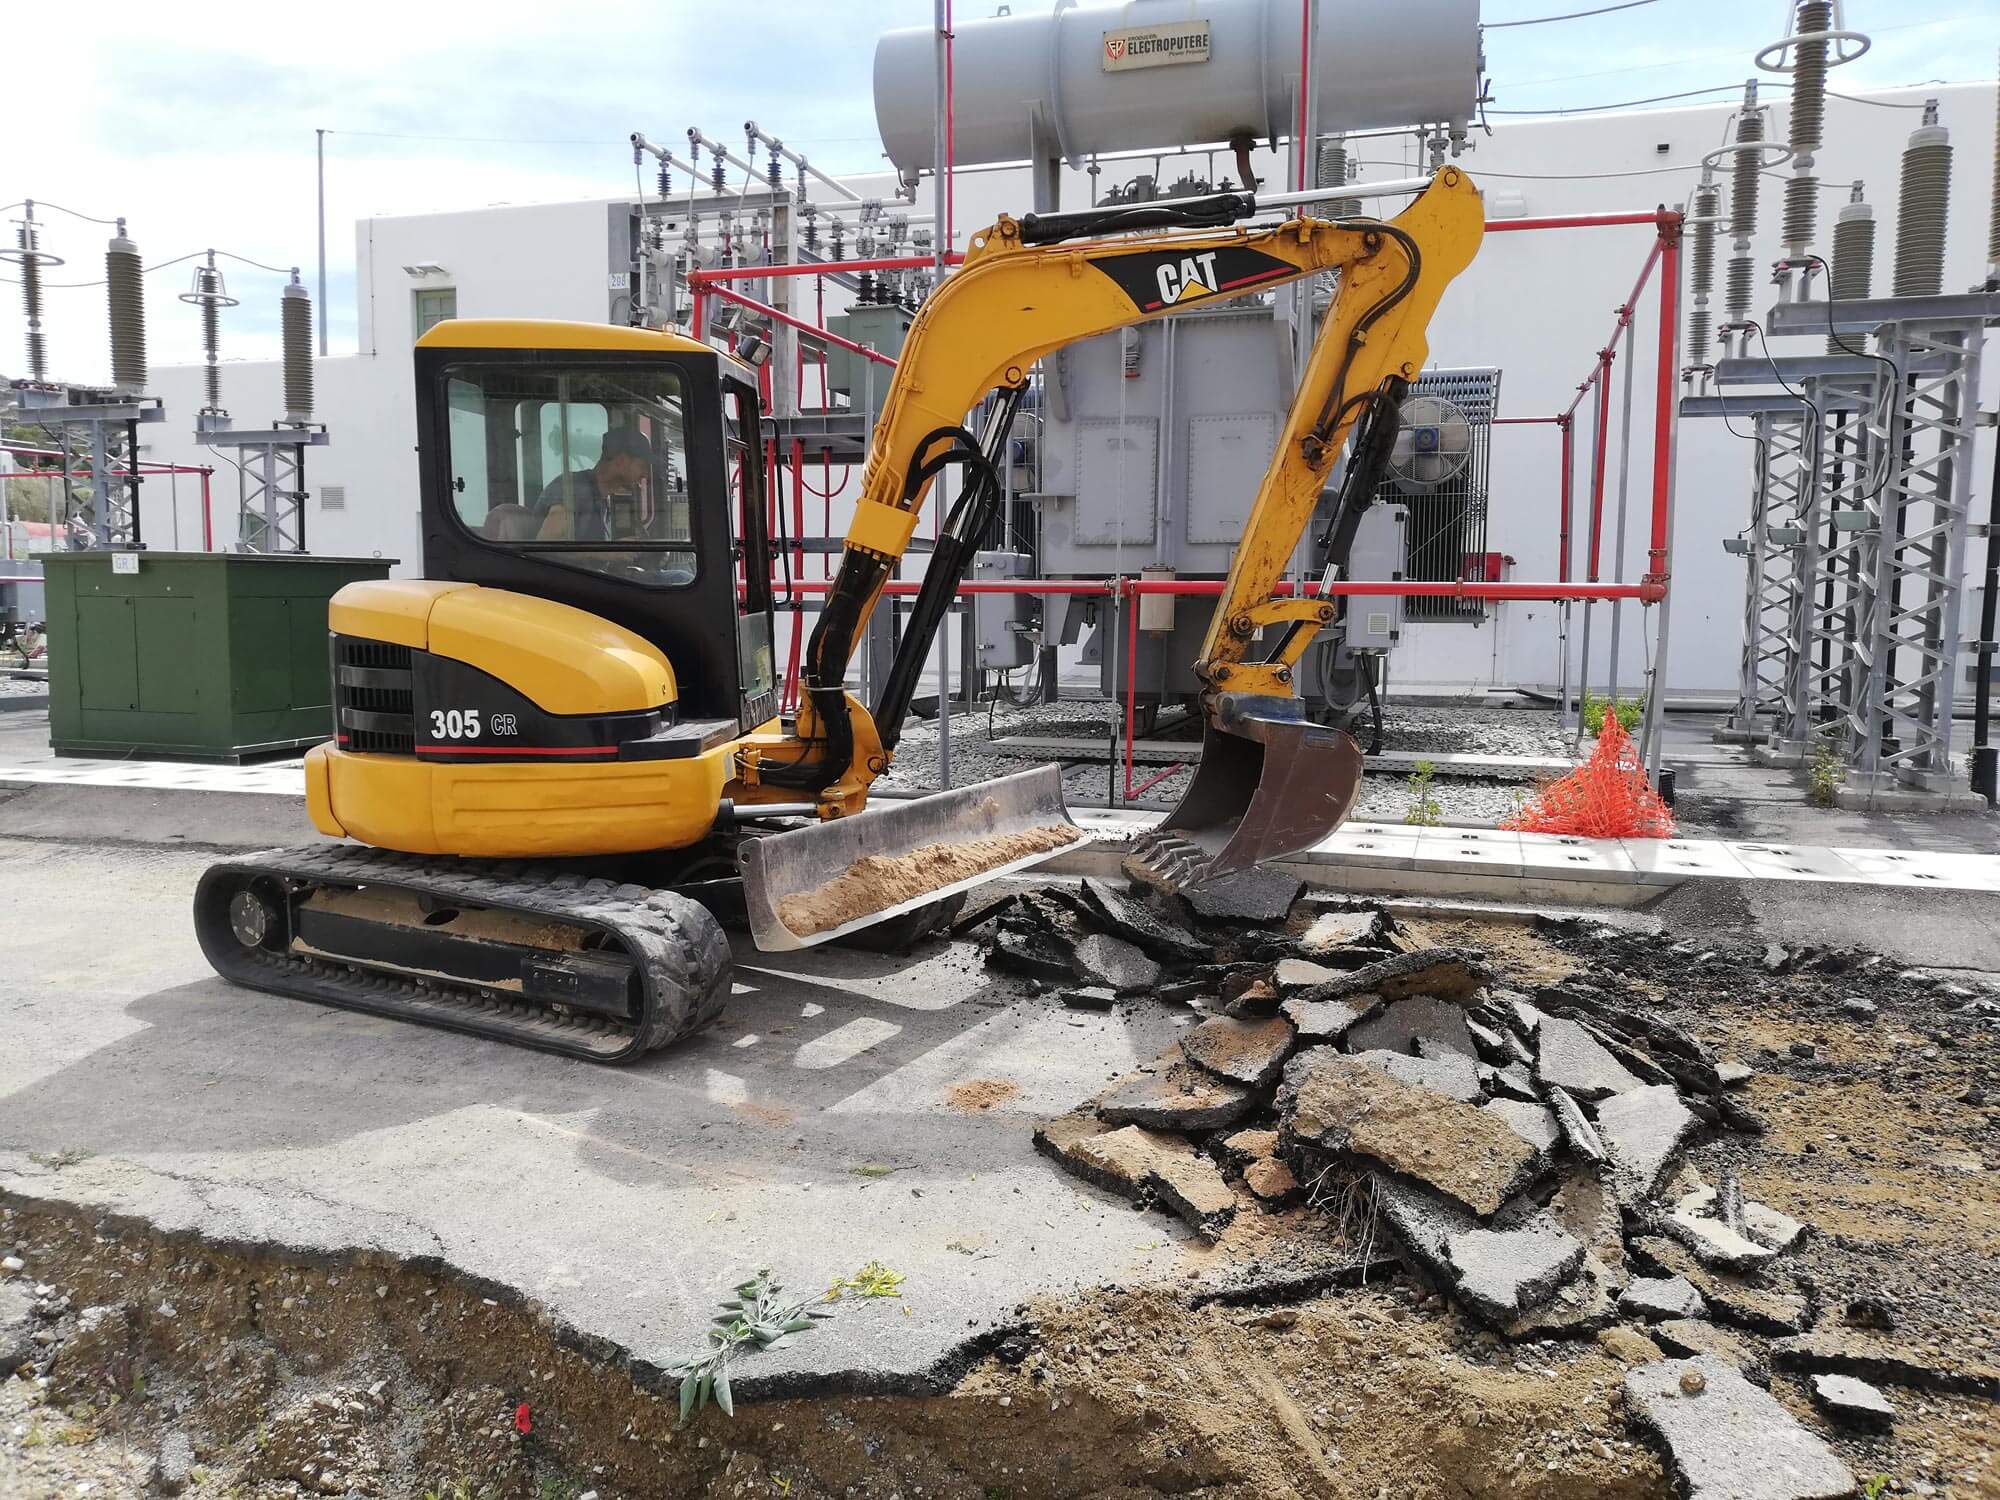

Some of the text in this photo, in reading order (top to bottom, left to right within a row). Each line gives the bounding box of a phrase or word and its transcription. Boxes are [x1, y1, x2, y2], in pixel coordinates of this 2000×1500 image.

[1127, 33, 1209, 55] ELECTROPUTERE
[1156, 251, 1219, 304] CAT
[430, 709, 519, 739] 305 CR
